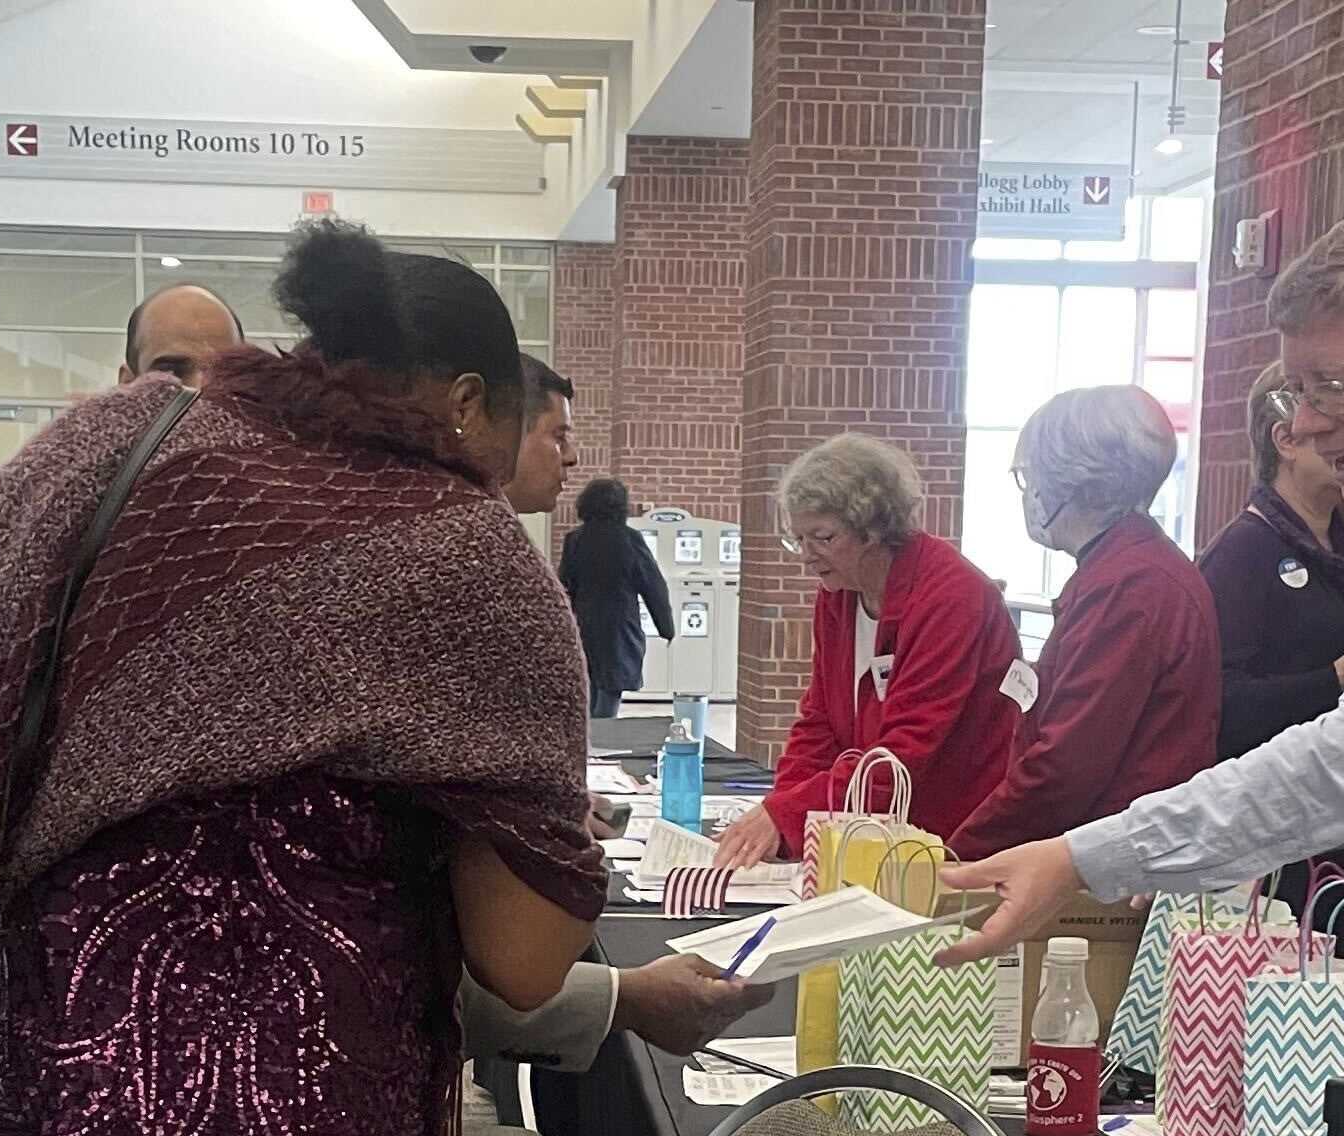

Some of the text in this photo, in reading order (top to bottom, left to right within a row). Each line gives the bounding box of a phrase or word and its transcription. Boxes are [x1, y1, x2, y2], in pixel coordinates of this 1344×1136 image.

[68, 125, 364, 158] Meeting Rooms 10 To 15
[978, 173, 1069, 195] llogg Lobby
[979, 197, 1071, 214] xhibit Halls
